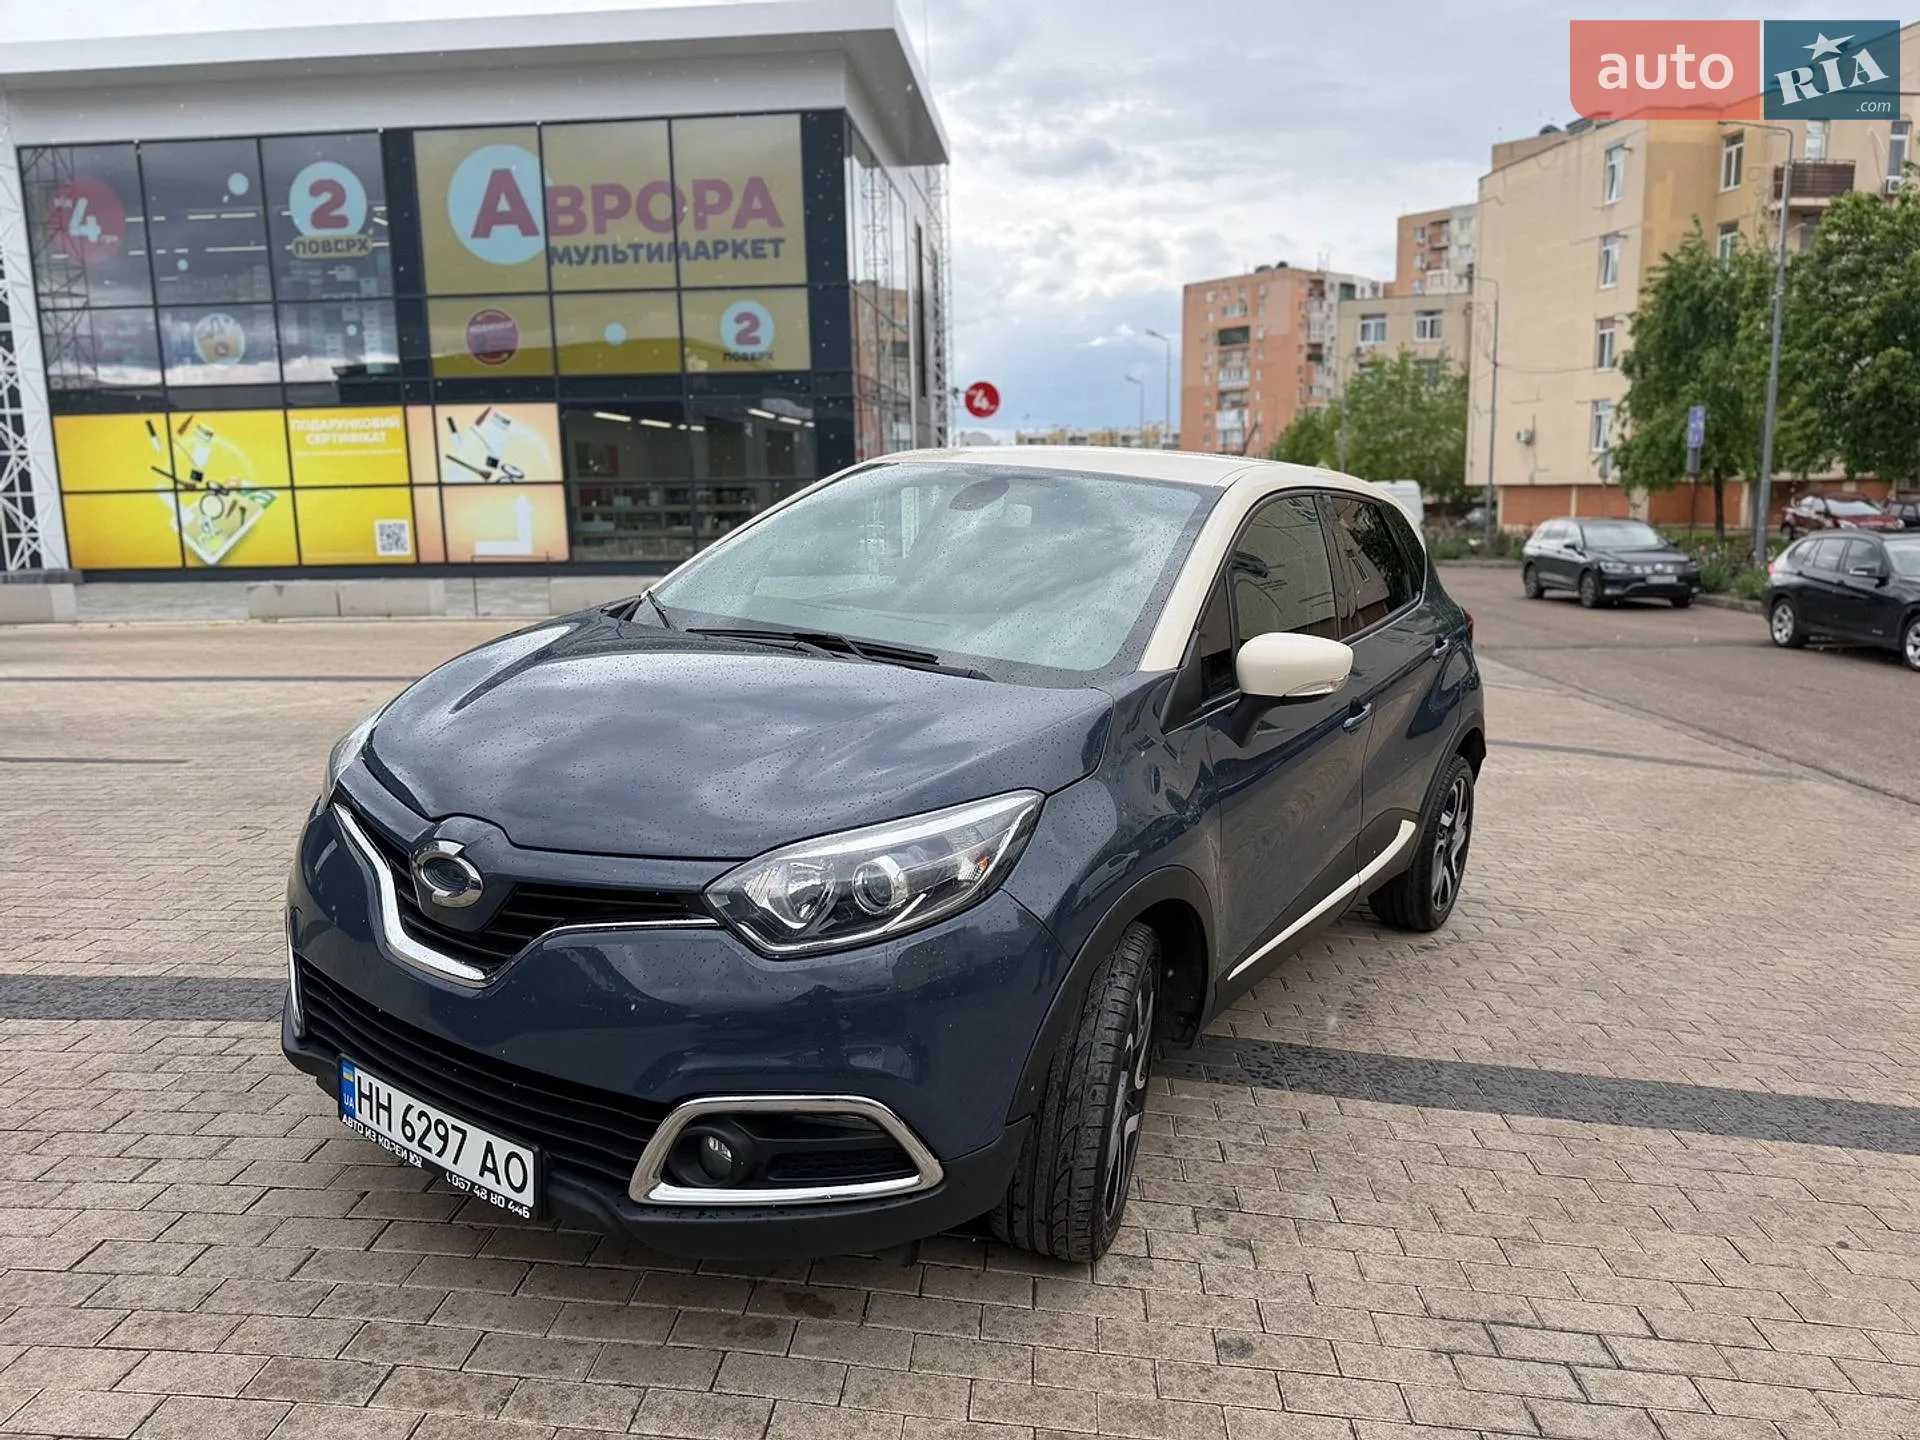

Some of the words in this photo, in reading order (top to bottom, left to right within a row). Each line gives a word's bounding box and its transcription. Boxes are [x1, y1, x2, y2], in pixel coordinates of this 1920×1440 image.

[68, 196, 102, 243] 4
[308, 178, 349, 230] 2
[294, 237, 370, 255] ПОВЕРХ
[549, 238, 786, 267] МУЛЬТИМАРКЕТ
[734, 311, 761, 346] 2
[342, 1094, 355, 1109] UA
[401, 1103, 468, 1166] 6297
[478, 1140, 528, 1194] AO
